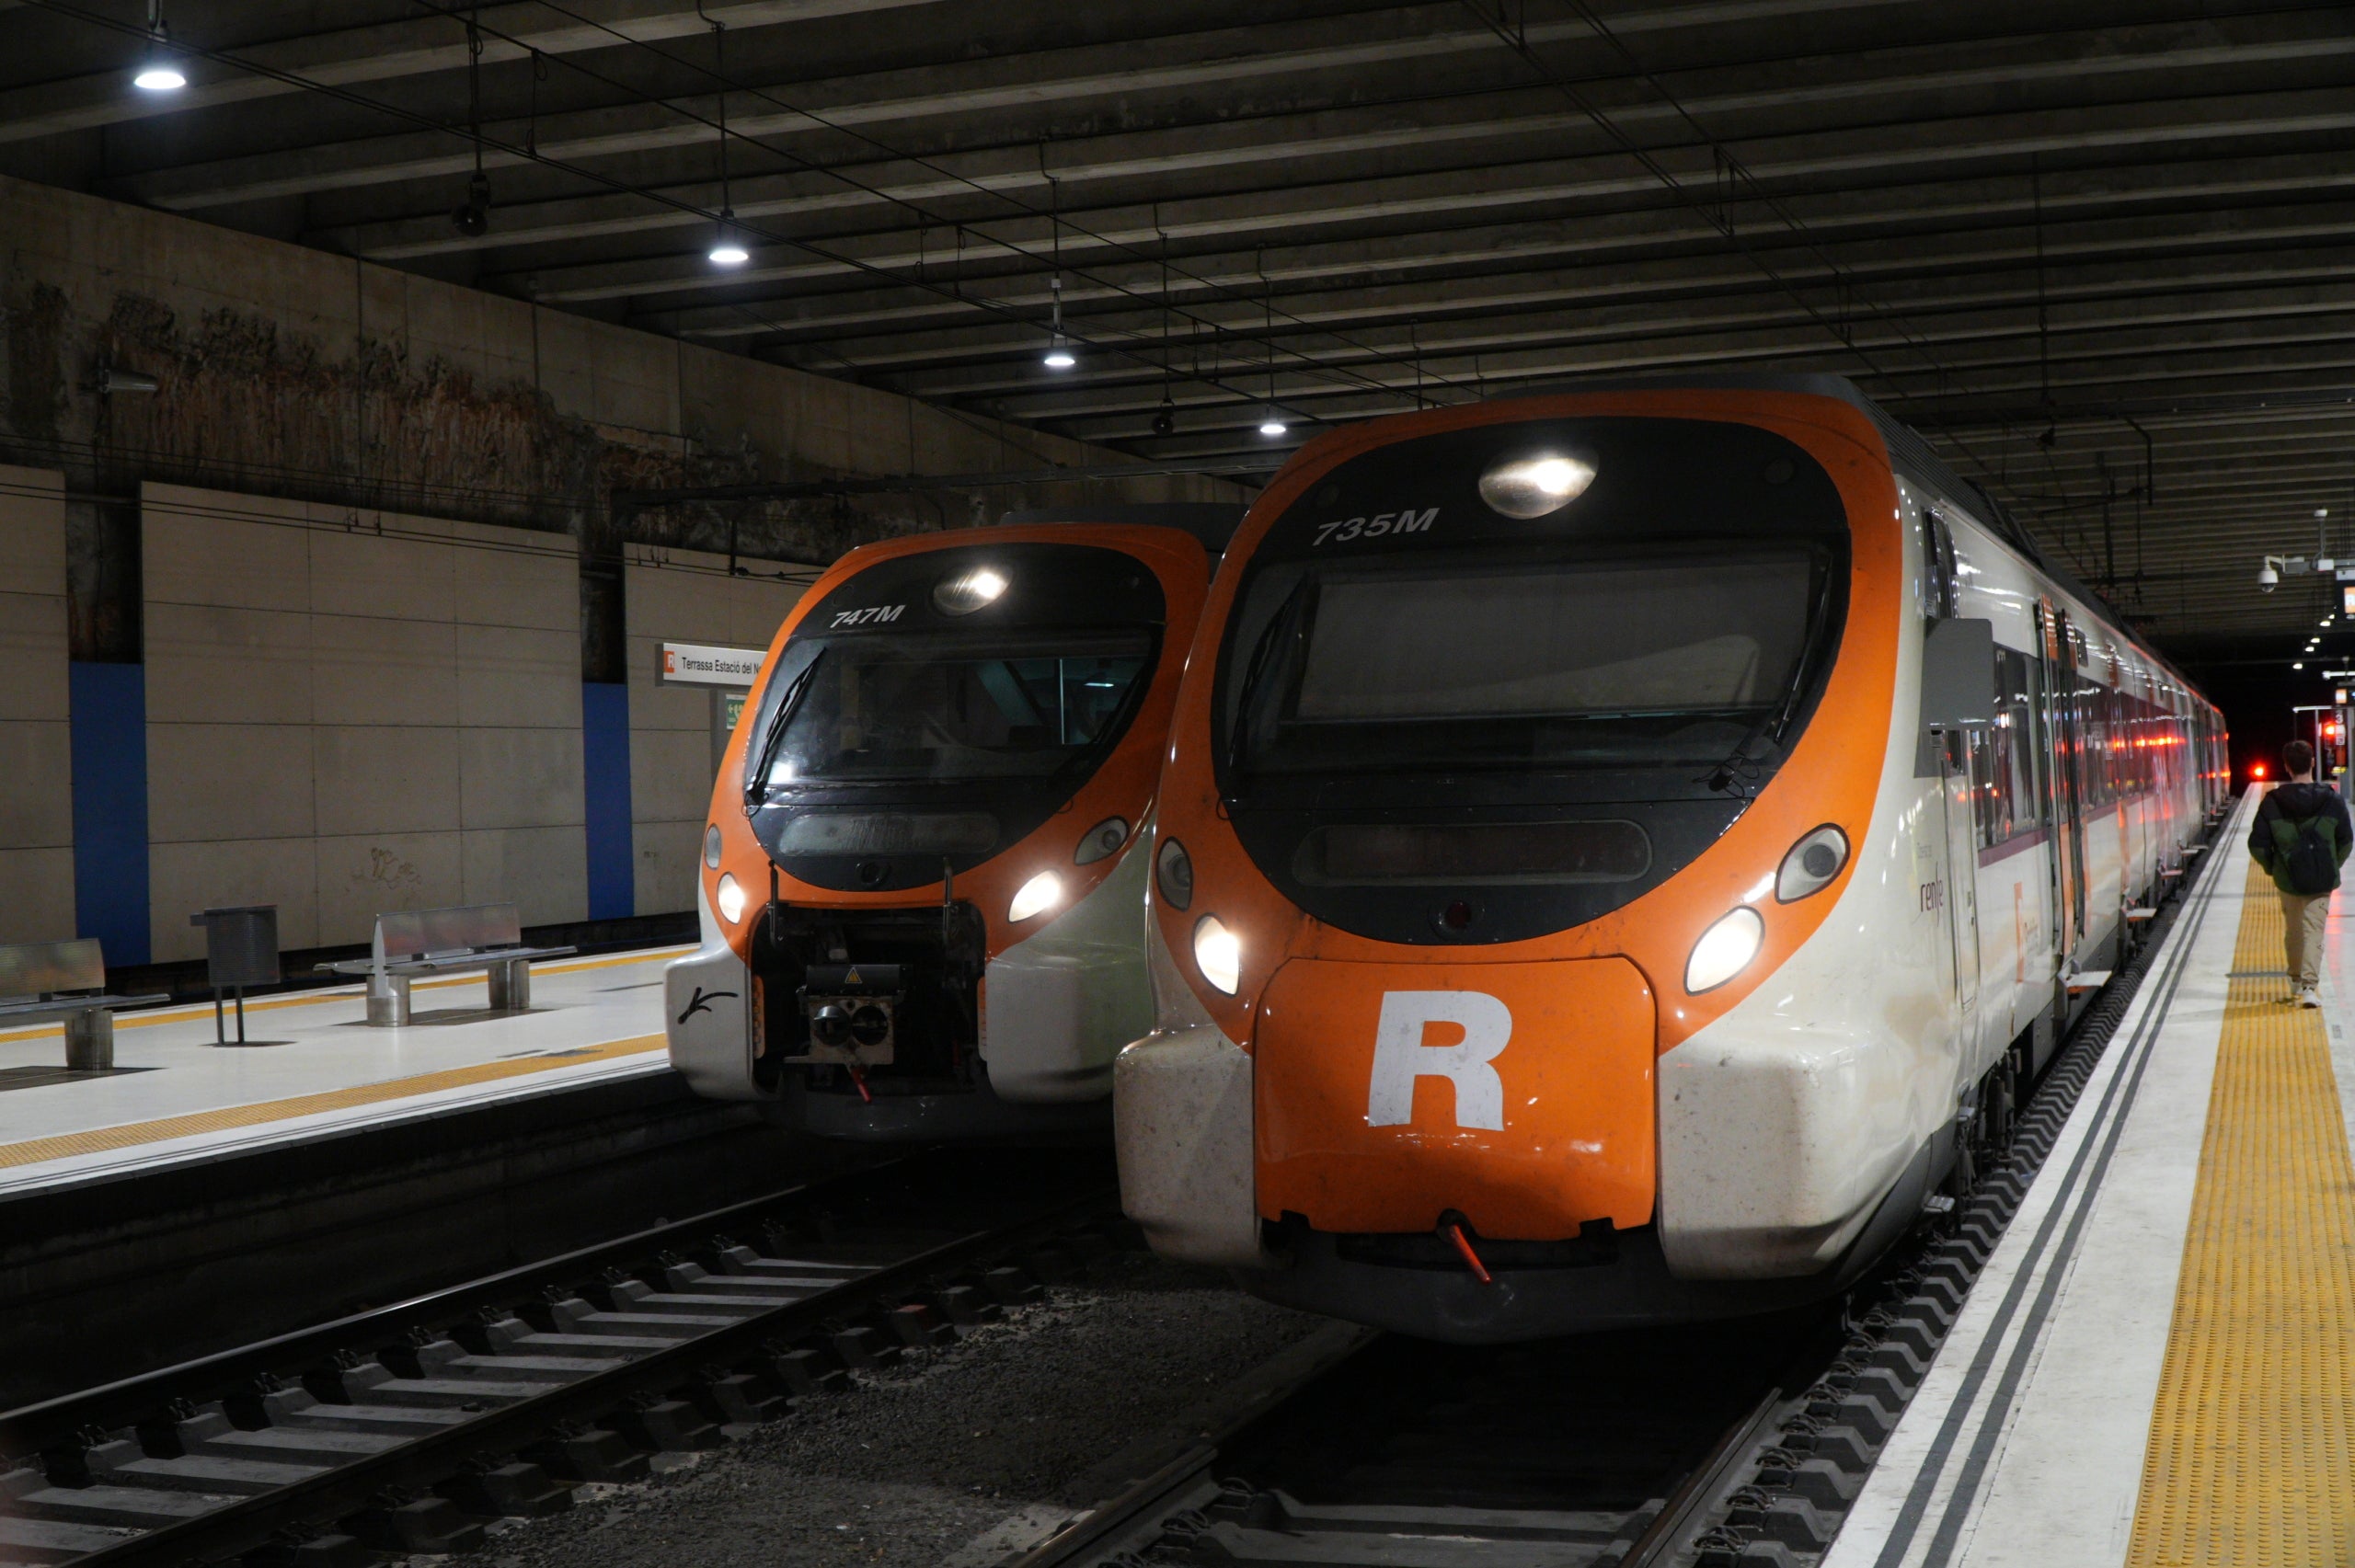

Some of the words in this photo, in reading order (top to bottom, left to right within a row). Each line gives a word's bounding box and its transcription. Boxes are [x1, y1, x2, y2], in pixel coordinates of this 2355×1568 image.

[1311, 507, 1441, 546] 735M
[829, 604, 906, 629] 747M
[682, 657, 713, 671] Terrassa
[715, 659, 740, 673] Estació
[741, 661, 752, 674] del
[1920, 860, 1944, 928] renfe
[1367, 990, 1513, 1133] R
